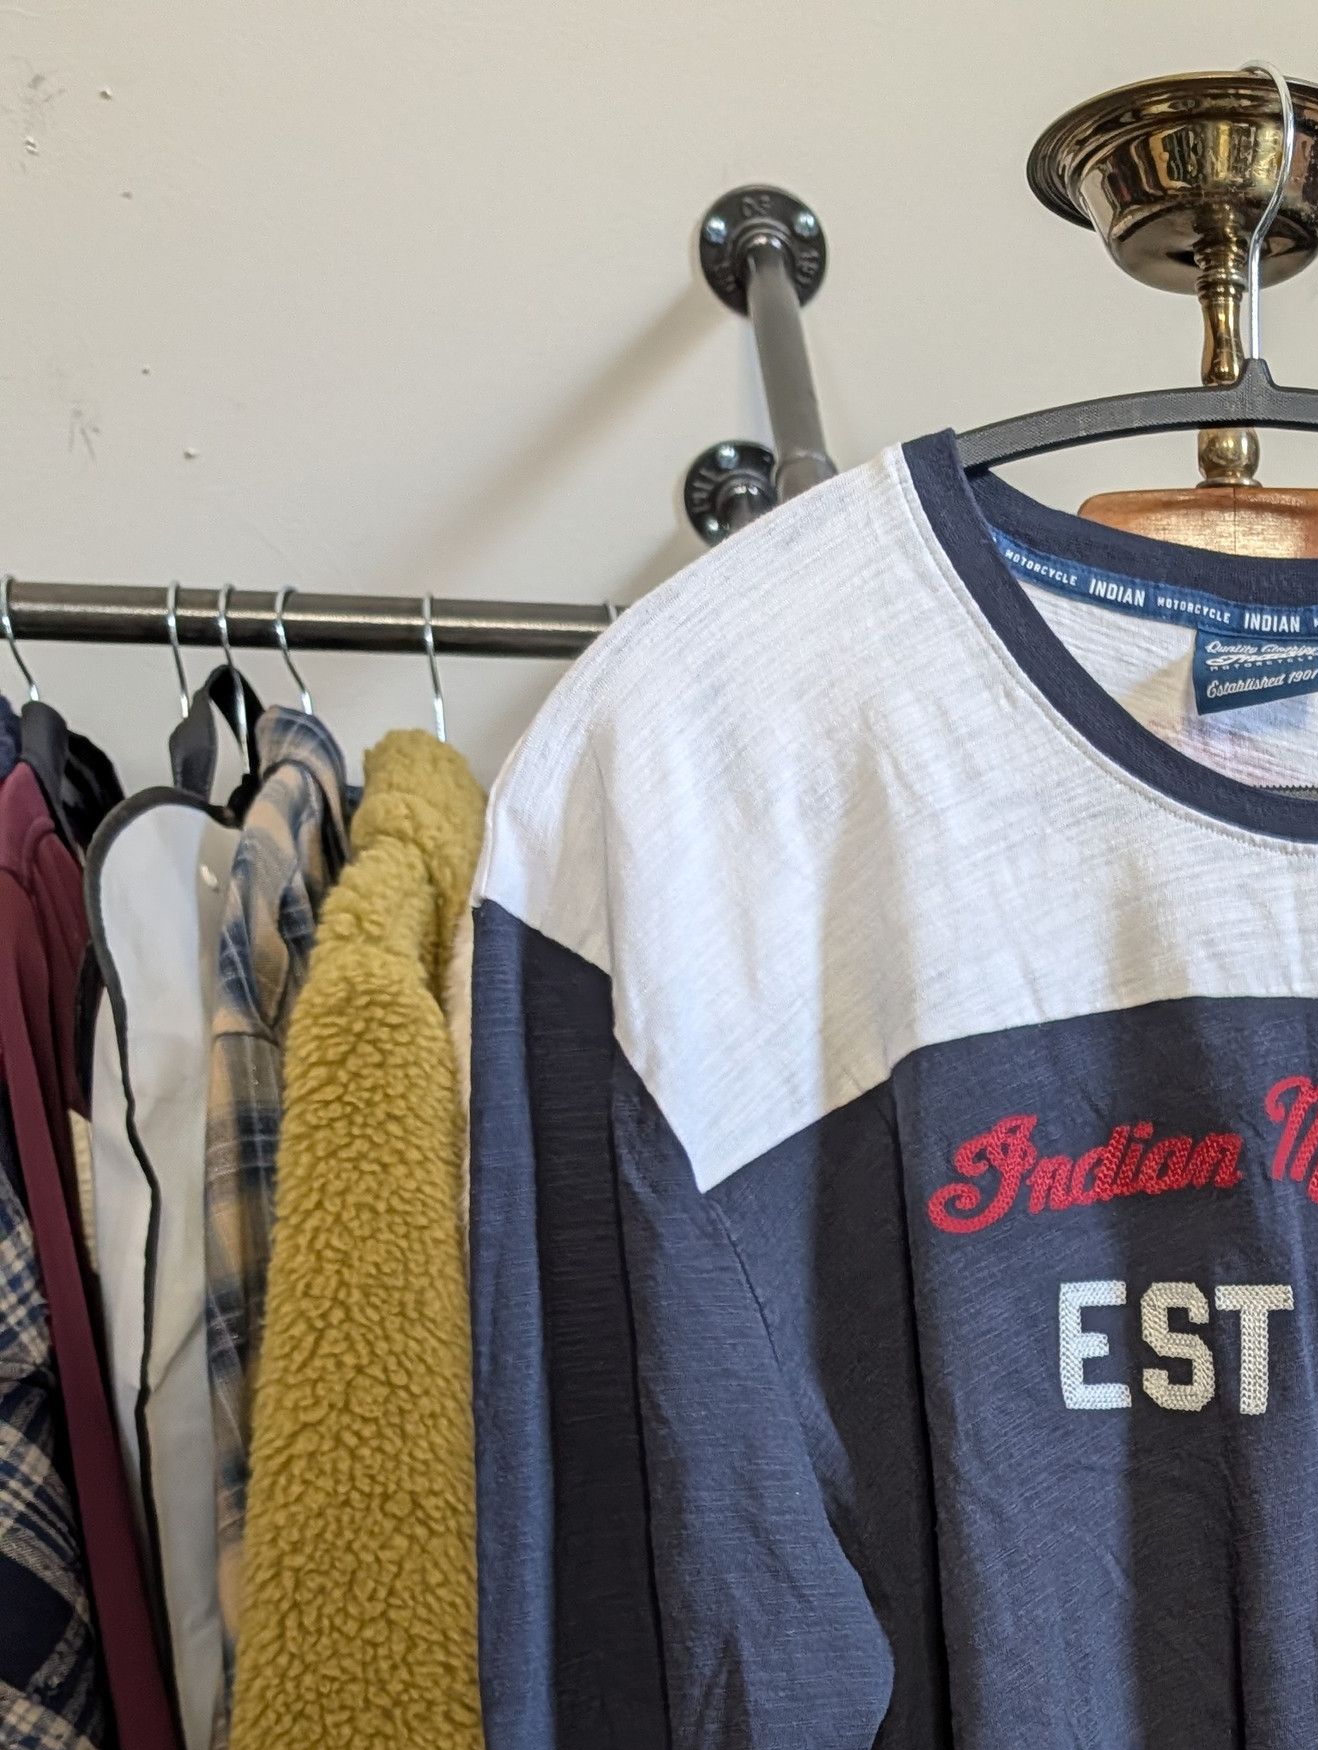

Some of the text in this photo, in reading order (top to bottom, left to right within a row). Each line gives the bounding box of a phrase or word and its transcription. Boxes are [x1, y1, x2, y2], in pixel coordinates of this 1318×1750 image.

[1004, 549, 1078, 586] MOTORCYCLE
[1088, 578, 1146, 608] INDIAN
[1157, 596, 1231, 624] MOTORCYCLE
[1244, 613, 1301, 633] INDIAN
[1205, 640, 1258, 655] Quality
[1207, 674, 1285, 698] Established
[928, 1113, 1242, 1234] Indian
[1058, 1280, 1294, 1415] EST
